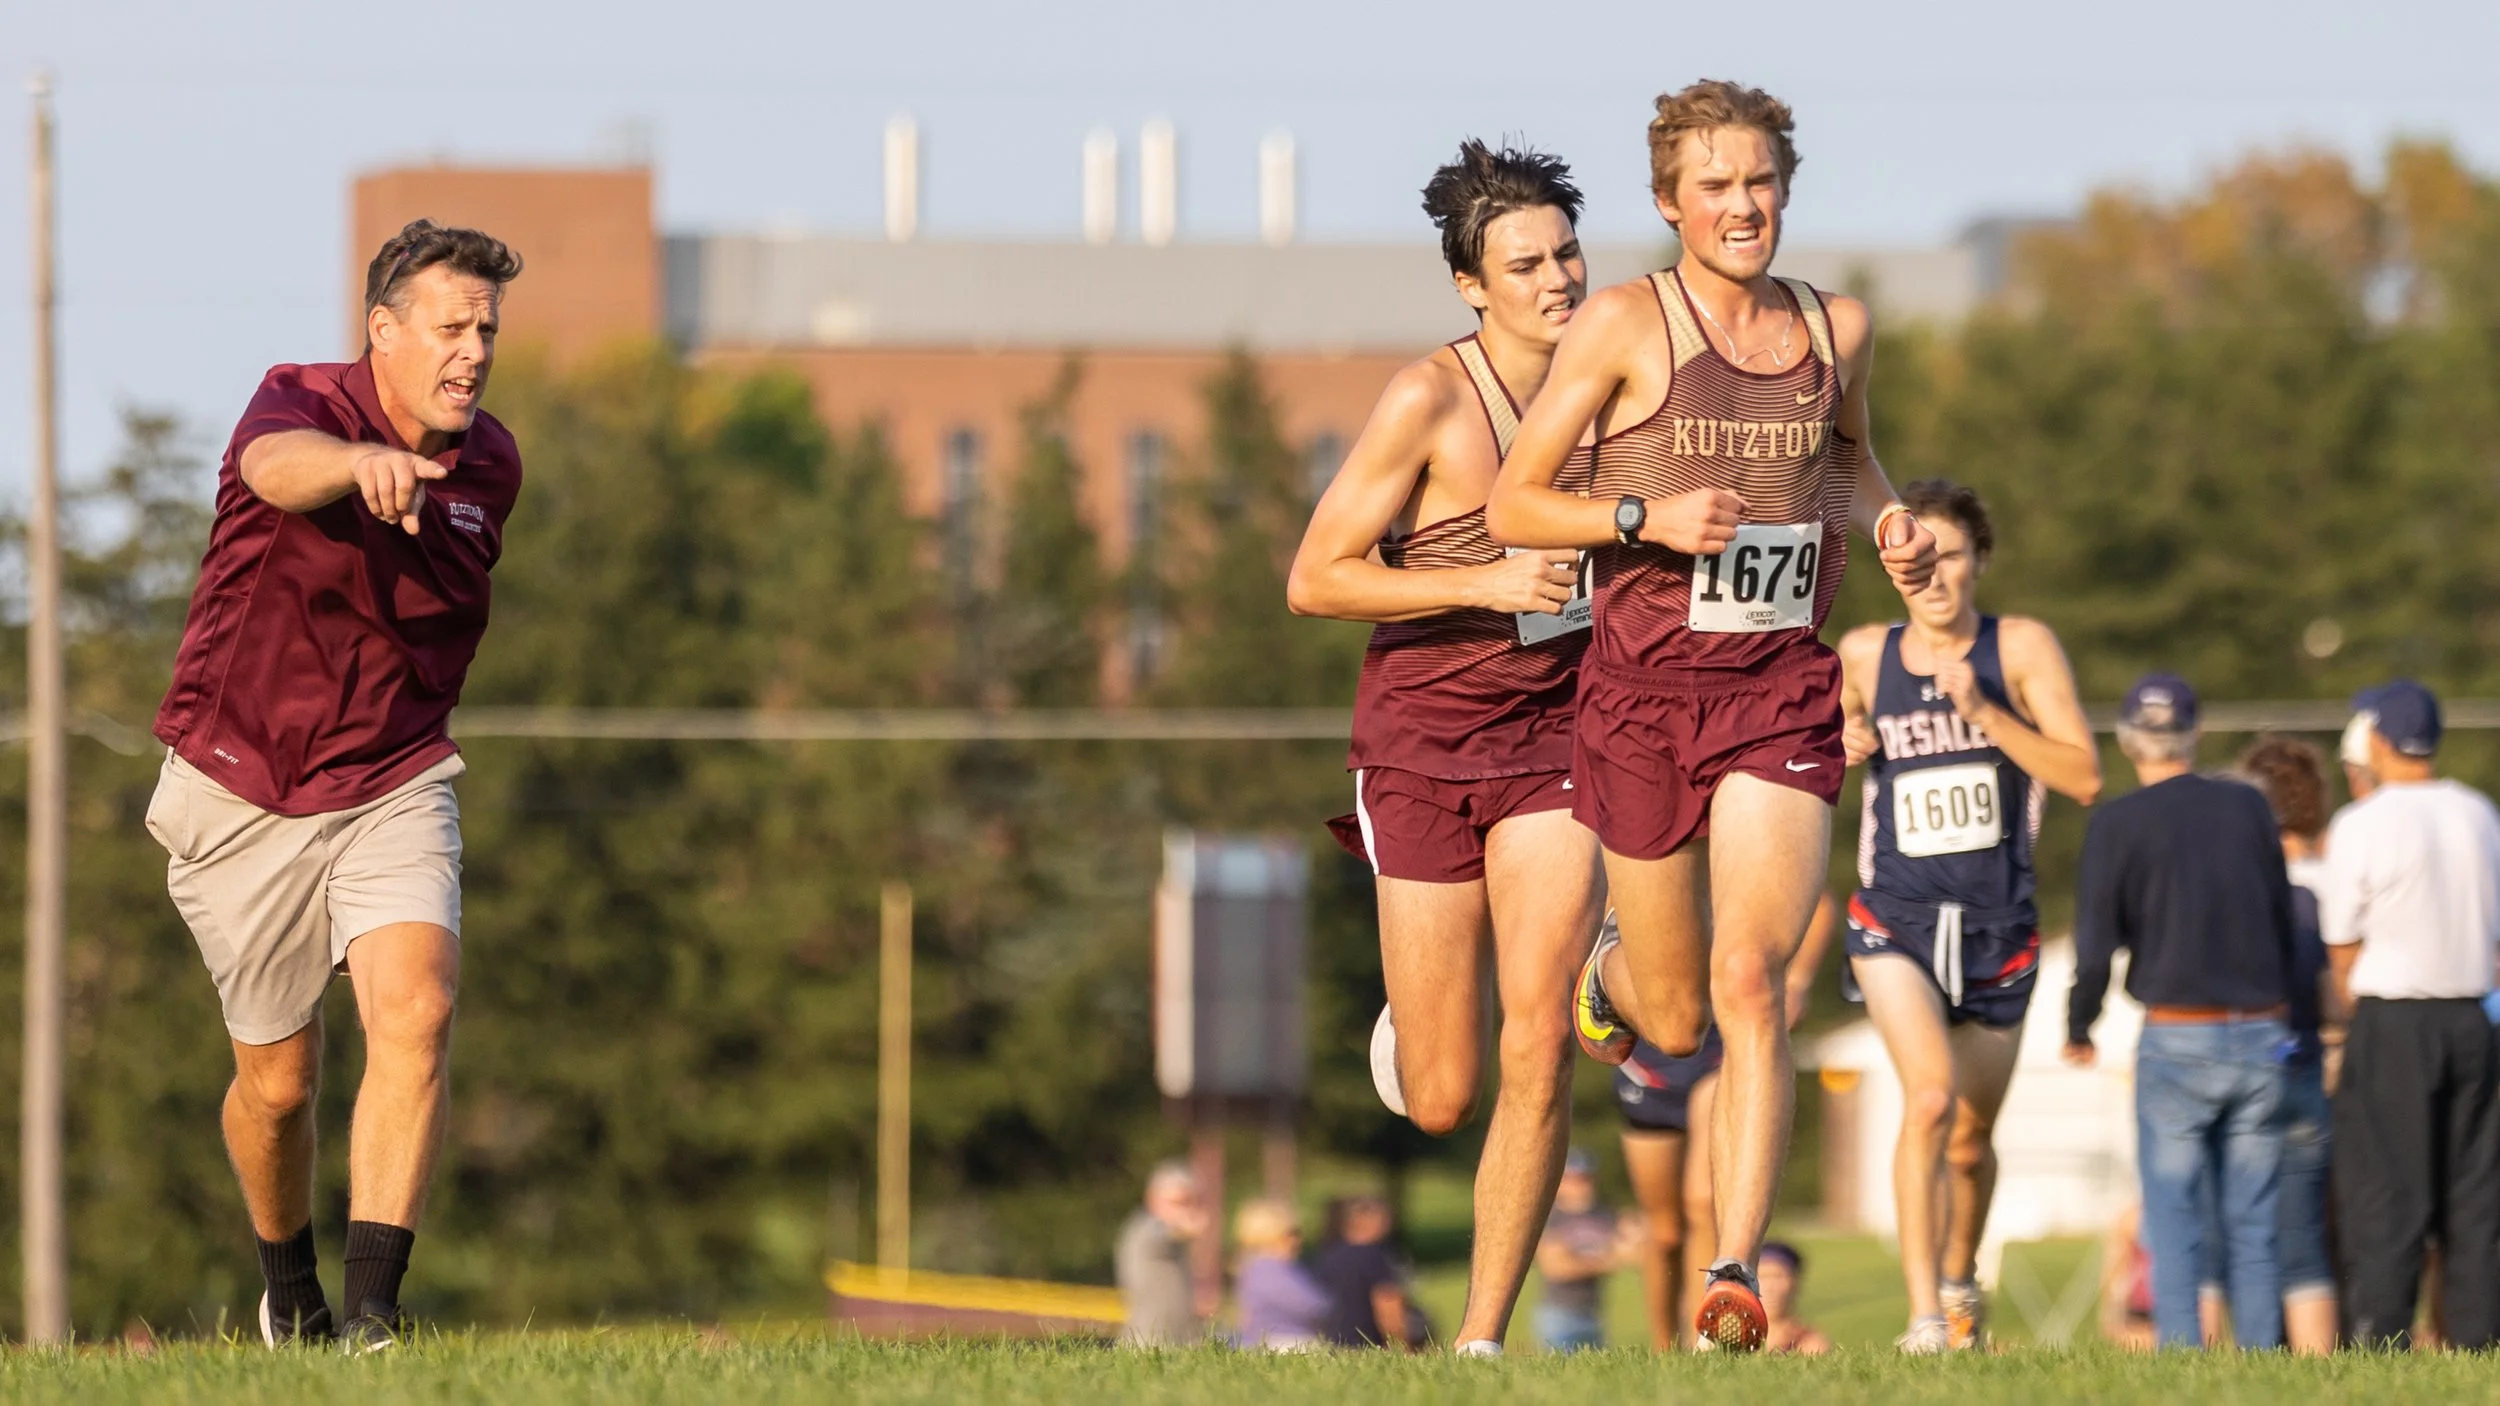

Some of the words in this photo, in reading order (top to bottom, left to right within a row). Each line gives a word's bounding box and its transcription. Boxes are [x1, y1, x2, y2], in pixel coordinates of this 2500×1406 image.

[1672, 418, 1836, 458] KUTZTOW
[1699, 541, 1818, 603] 1679
[1876, 709, 1999, 762] DESALE
[1903, 782, 1994, 835] 1609
